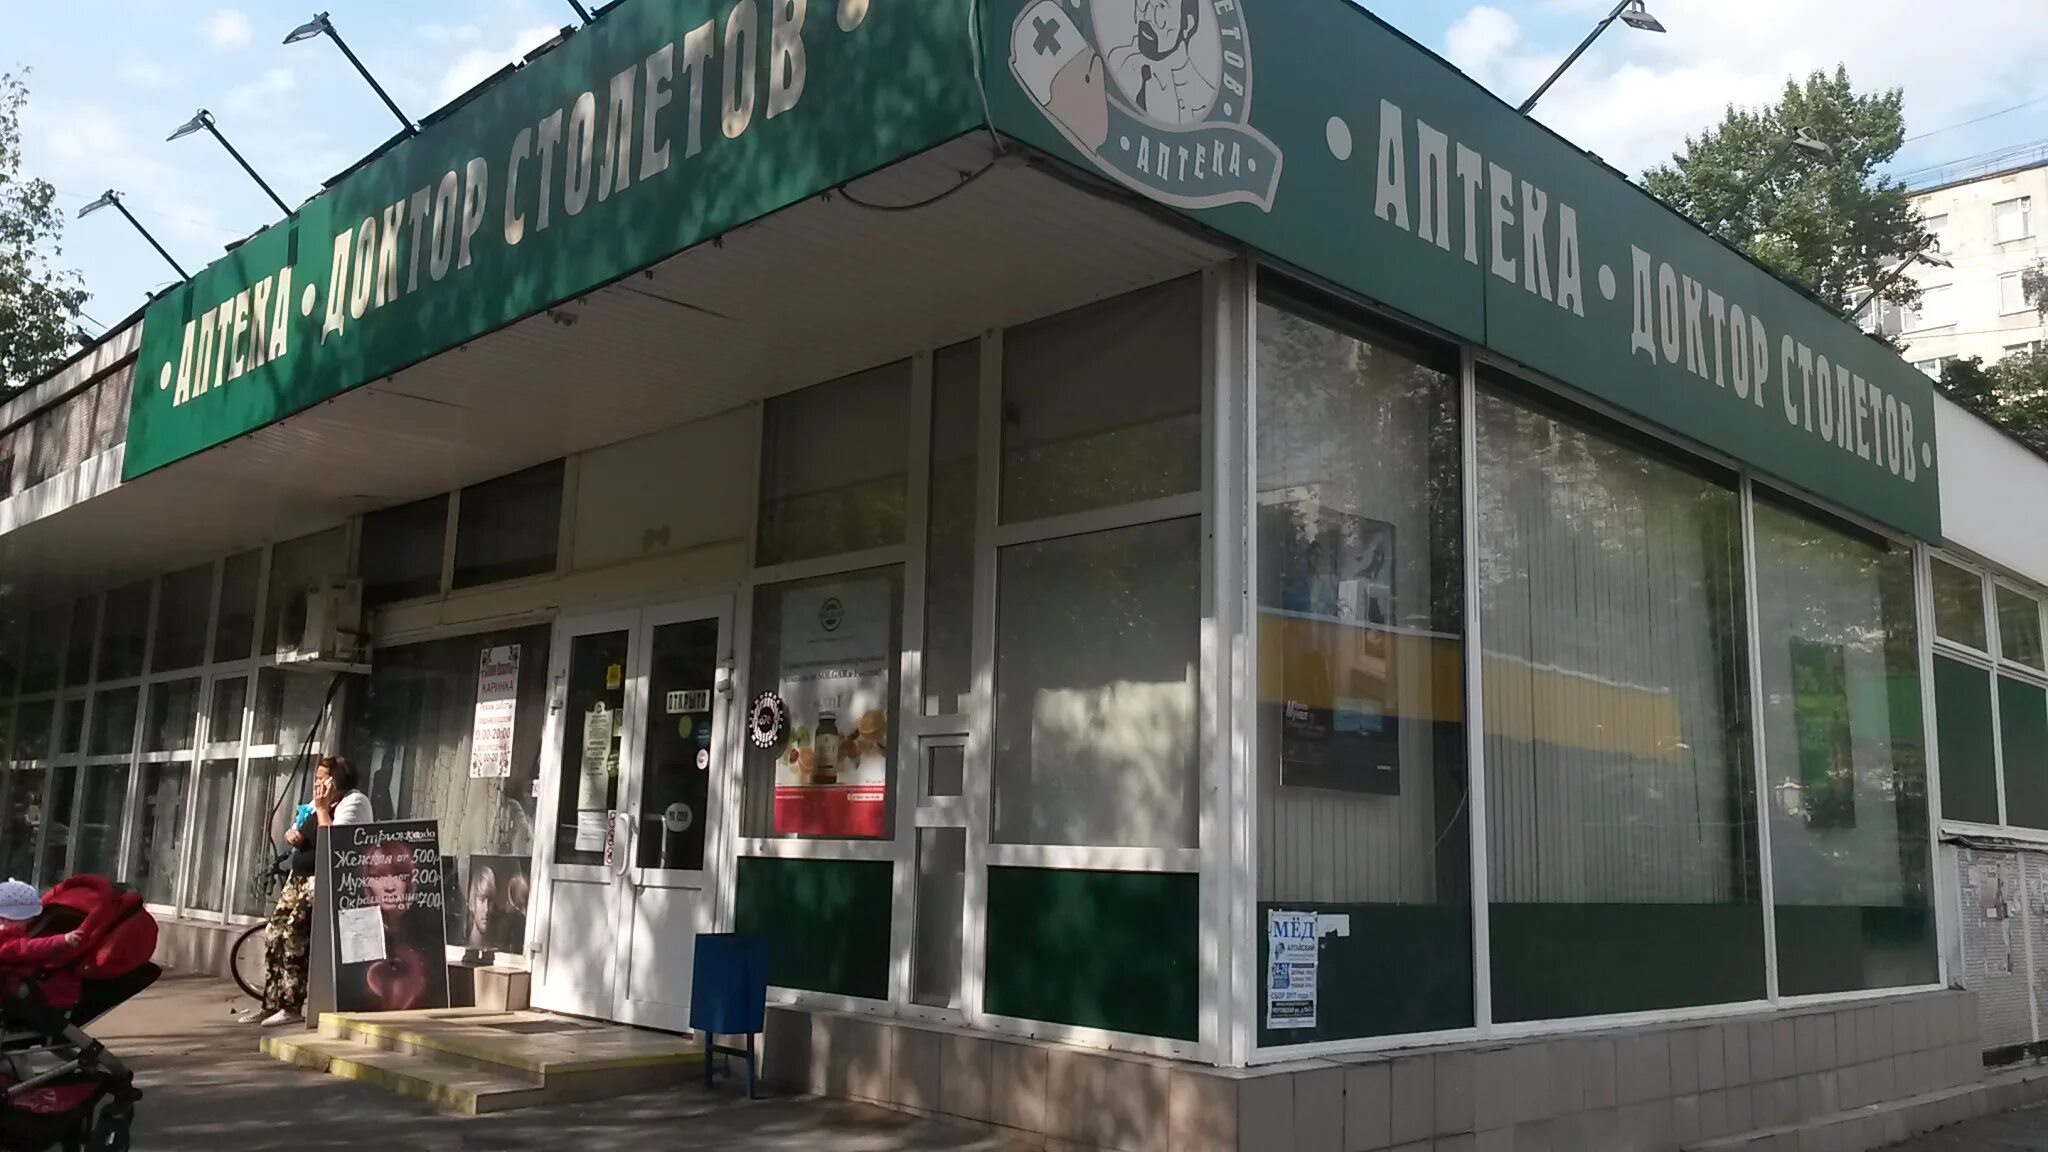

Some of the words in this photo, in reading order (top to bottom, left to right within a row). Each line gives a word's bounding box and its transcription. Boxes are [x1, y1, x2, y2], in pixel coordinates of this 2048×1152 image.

[173, 266, 292, 407] АПТЕКА
[321, 156, 489, 346] ДОКТОР
[504, 0, 807, 245] СТОЛЕТОВ
[1136, 135, 1241, 183] АПТЕКА
[1374, 98, 1585, 318] АПТЕКА
[1631, 244, 1769, 407] ДОКТОР
[1780, 334, 1917, 483] СТОЛЕТОВ
[1273, 917, 1315, 941] МЁД
